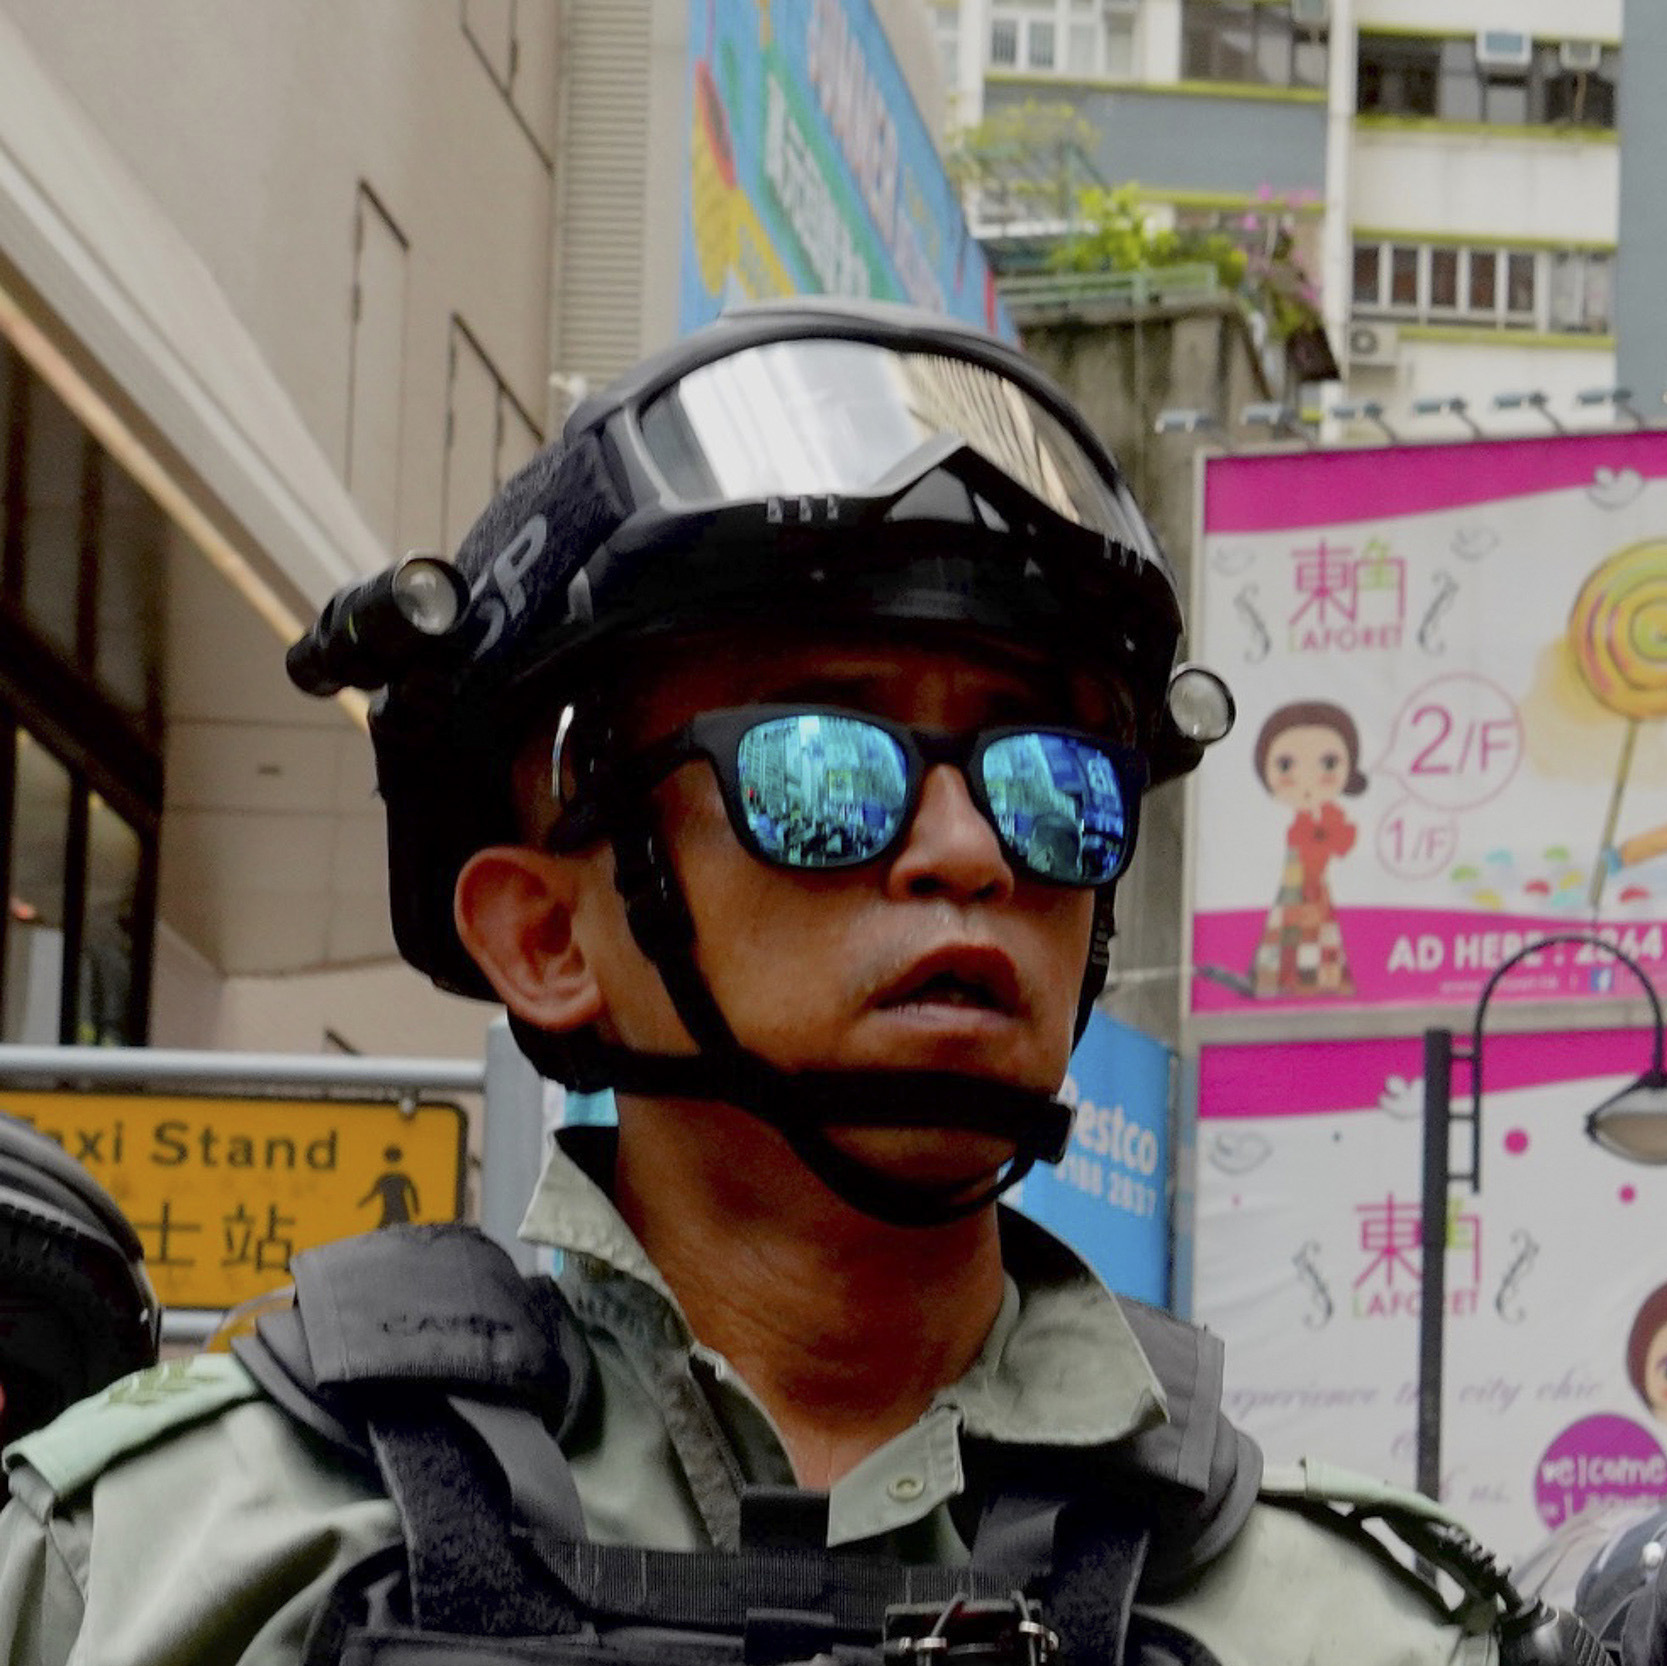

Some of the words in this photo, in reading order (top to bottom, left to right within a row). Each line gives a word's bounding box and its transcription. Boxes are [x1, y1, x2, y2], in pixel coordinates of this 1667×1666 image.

[1409, 704, 1518, 775] 2/F
[1388, 817, 1450, 862] 1/F
[1387, 935, 1444, 972] AD
[149, 1116, 338, 1171] Stand
